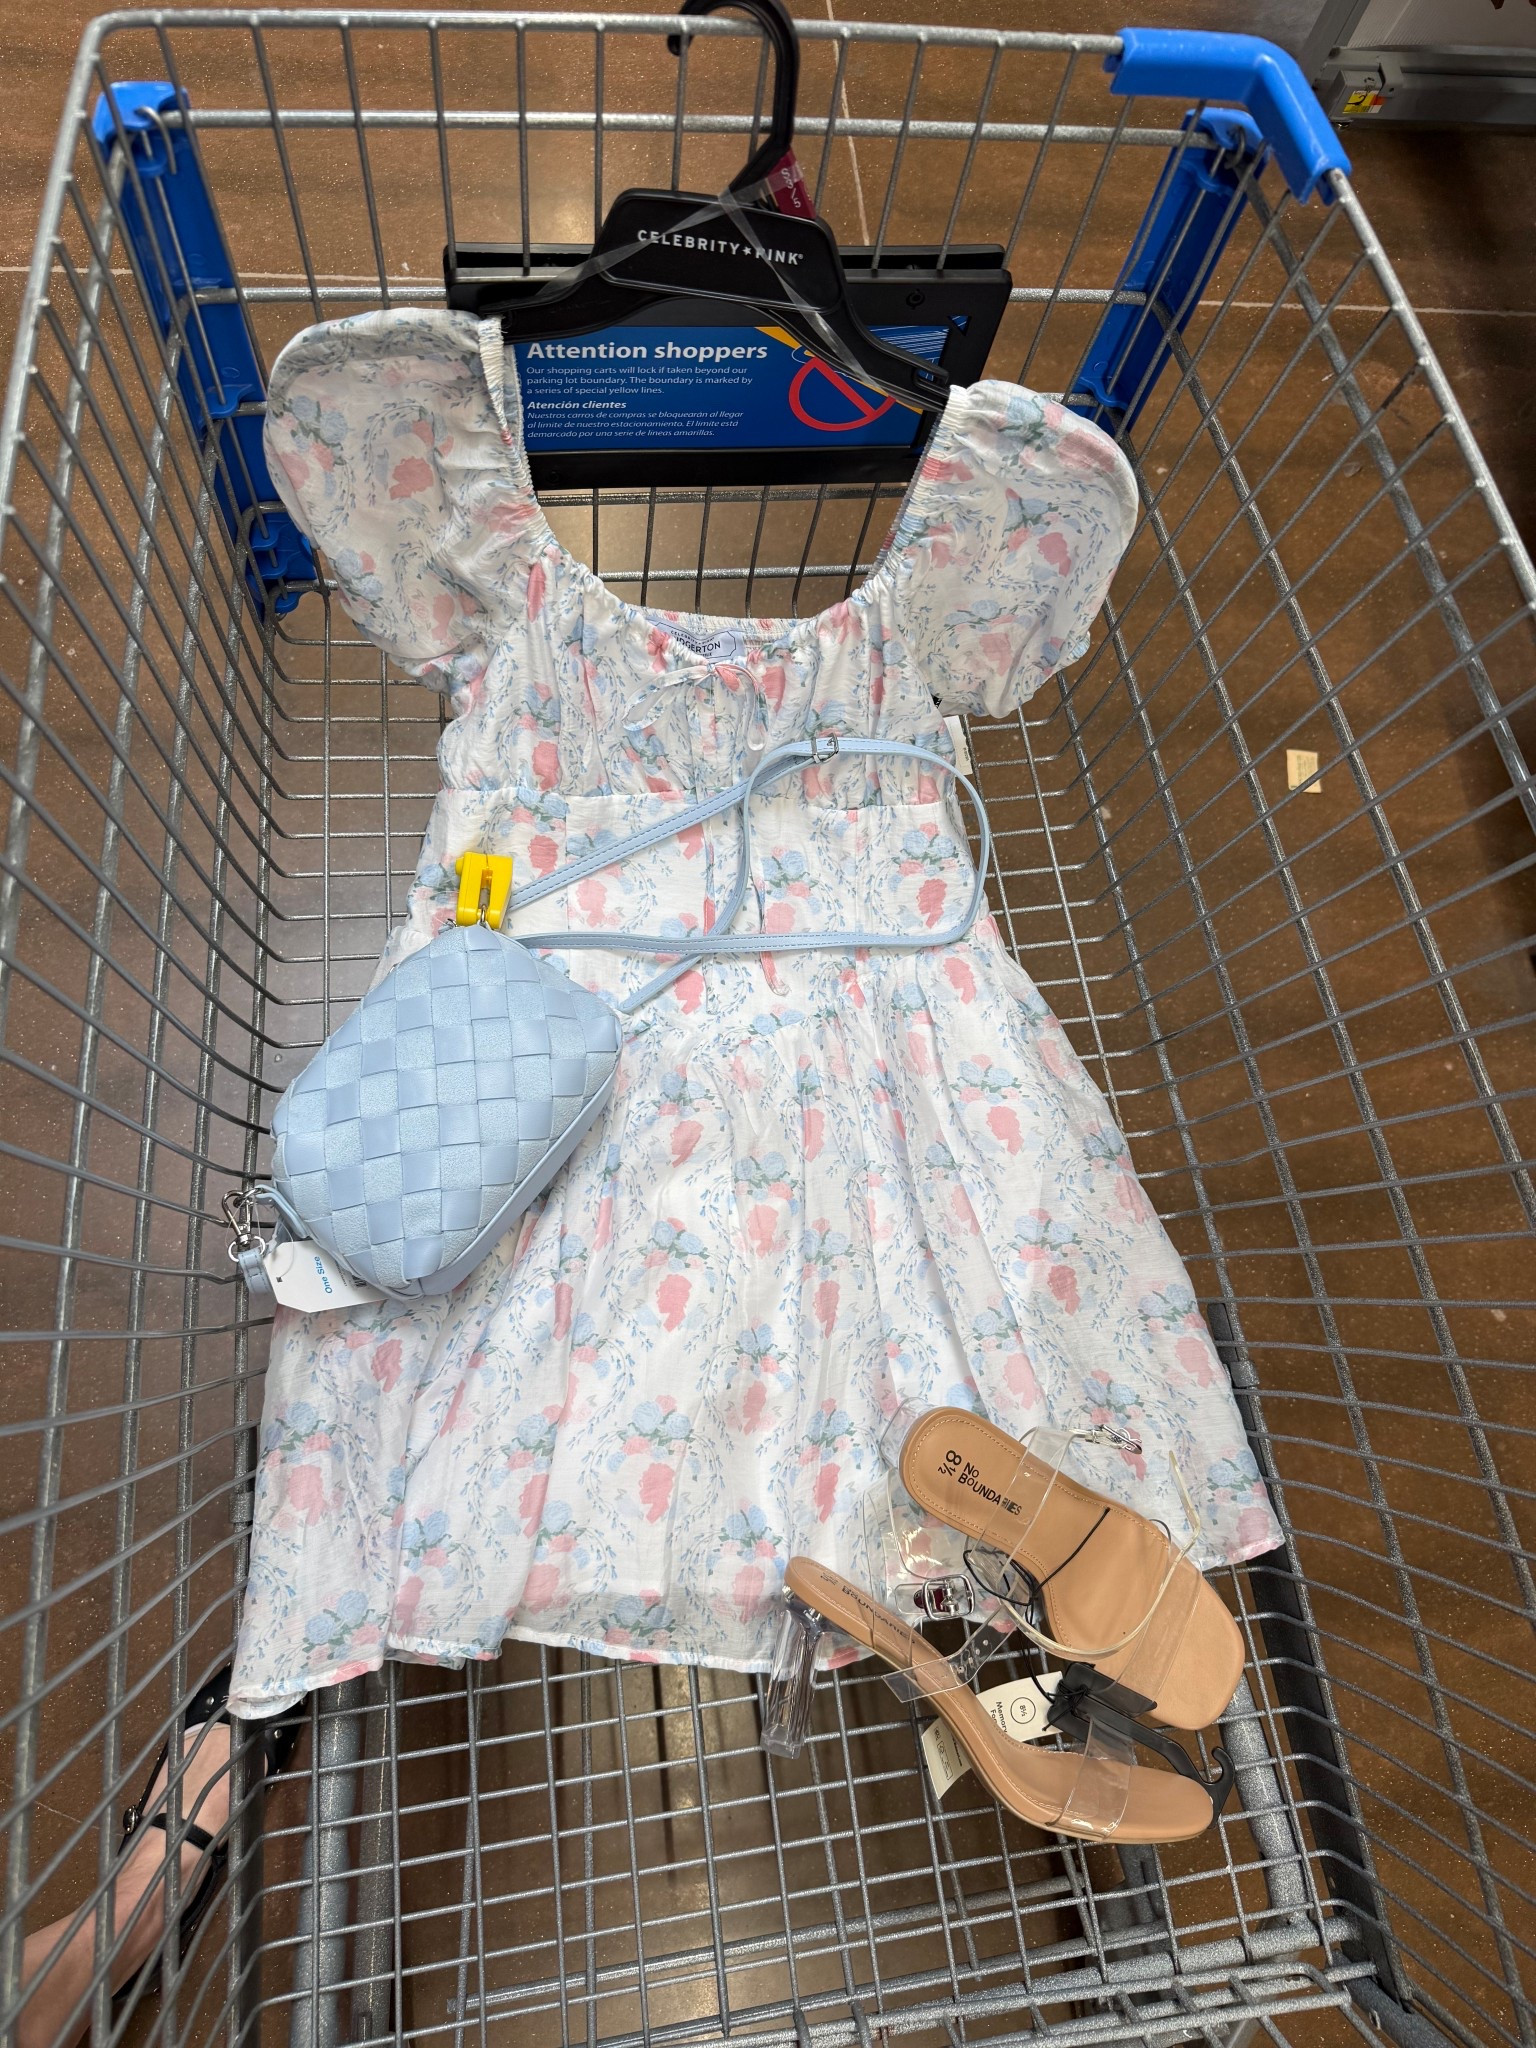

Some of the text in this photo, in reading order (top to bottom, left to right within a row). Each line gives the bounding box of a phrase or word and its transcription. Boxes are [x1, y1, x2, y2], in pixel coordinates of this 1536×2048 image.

[637, 229, 740, 255] CELEBRITY
[526, 341, 768, 363] Attention shoppers
[547, 366, 592, 376] shopping
[695, 366, 730, 376] beyond
[526, 376, 753, 386] parking lot boundary. The boundary is marked by
[575, 386, 607, 396] special
[608, 386, 639, 396] yellow
[527, 401, 627, 409] Atención clientes
[608, 412, 646, 420] compras
[658, 411, 708, 419] bloquearán
[719, 411, 744, 419] llegar
[527, 421, 537, 429] al
[720, 419, 739, 427] está
[527, 430, 578, 438] demarcado
[314, 1256, 333, 1294] One Size
[957, 1472, 1022, 1516] BOUNDARIES
[996, 1701, 1008, 1733] Memory
